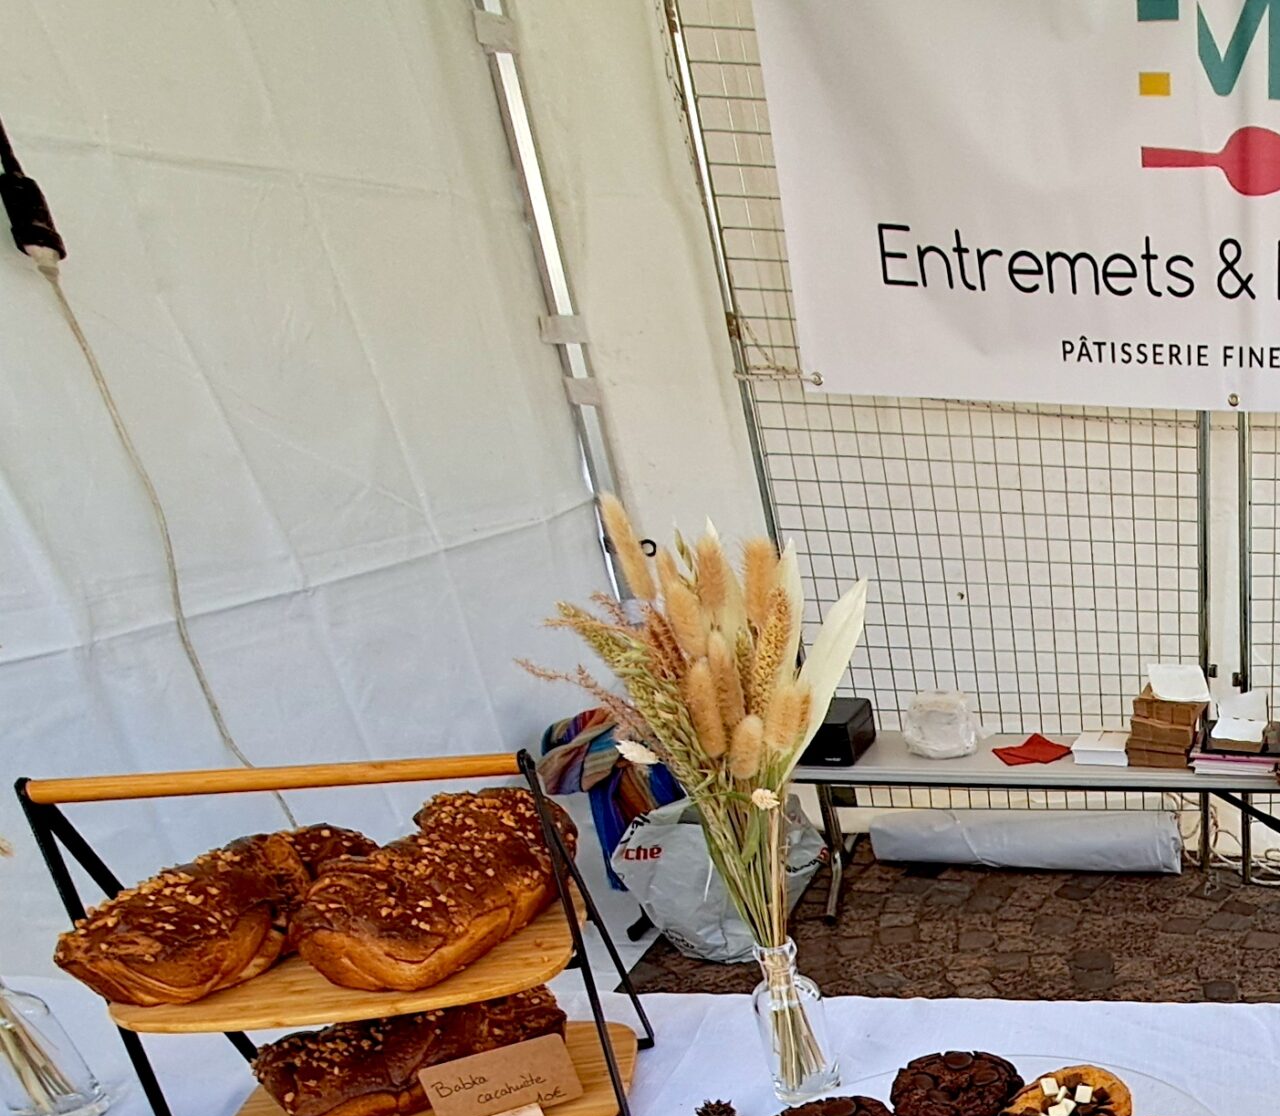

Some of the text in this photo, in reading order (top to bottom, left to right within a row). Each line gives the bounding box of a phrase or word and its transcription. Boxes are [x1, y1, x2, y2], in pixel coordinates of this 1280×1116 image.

[877, 222, 1196, 298] Entremets
[1216, 237, 1257, 300] &
[1061, 335, 1210, 367] PÂTISSERIE
[431, 1074, 488, 1099] Babka
[477, 1073, 547, 1105] cacahuète
[535, 1086, 567, 1103] 10€
